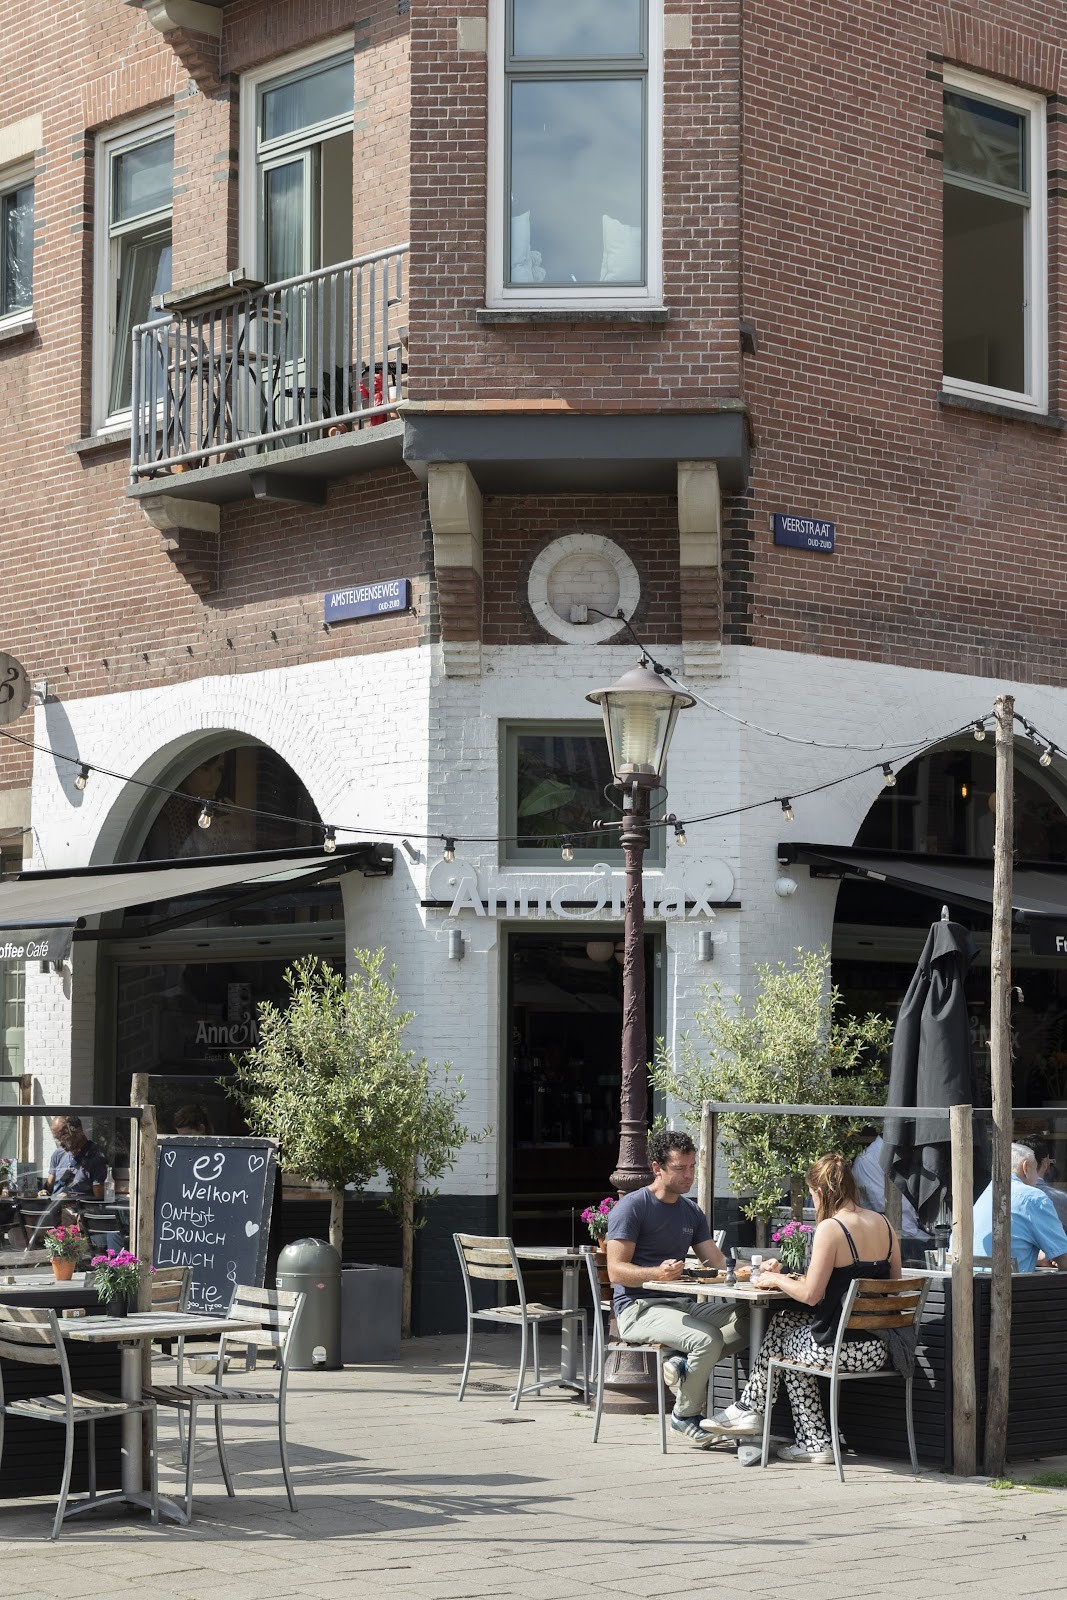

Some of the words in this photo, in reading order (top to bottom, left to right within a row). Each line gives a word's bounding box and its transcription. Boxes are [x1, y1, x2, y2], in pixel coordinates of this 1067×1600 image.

[781, 516, 831, 538] VEERSTRAAT
[807, 538, 833, 549] OUD-ZUID
[330, 582, 399, 608] AMSTELVEENSEWEG
[378, 599, 400, 611] OUD-ZUID
[26, 940, 49, 958] Café
[160, 1221, 226, 1246] BRUNCH
[157, 1243, 215, 1269] LUNCH
